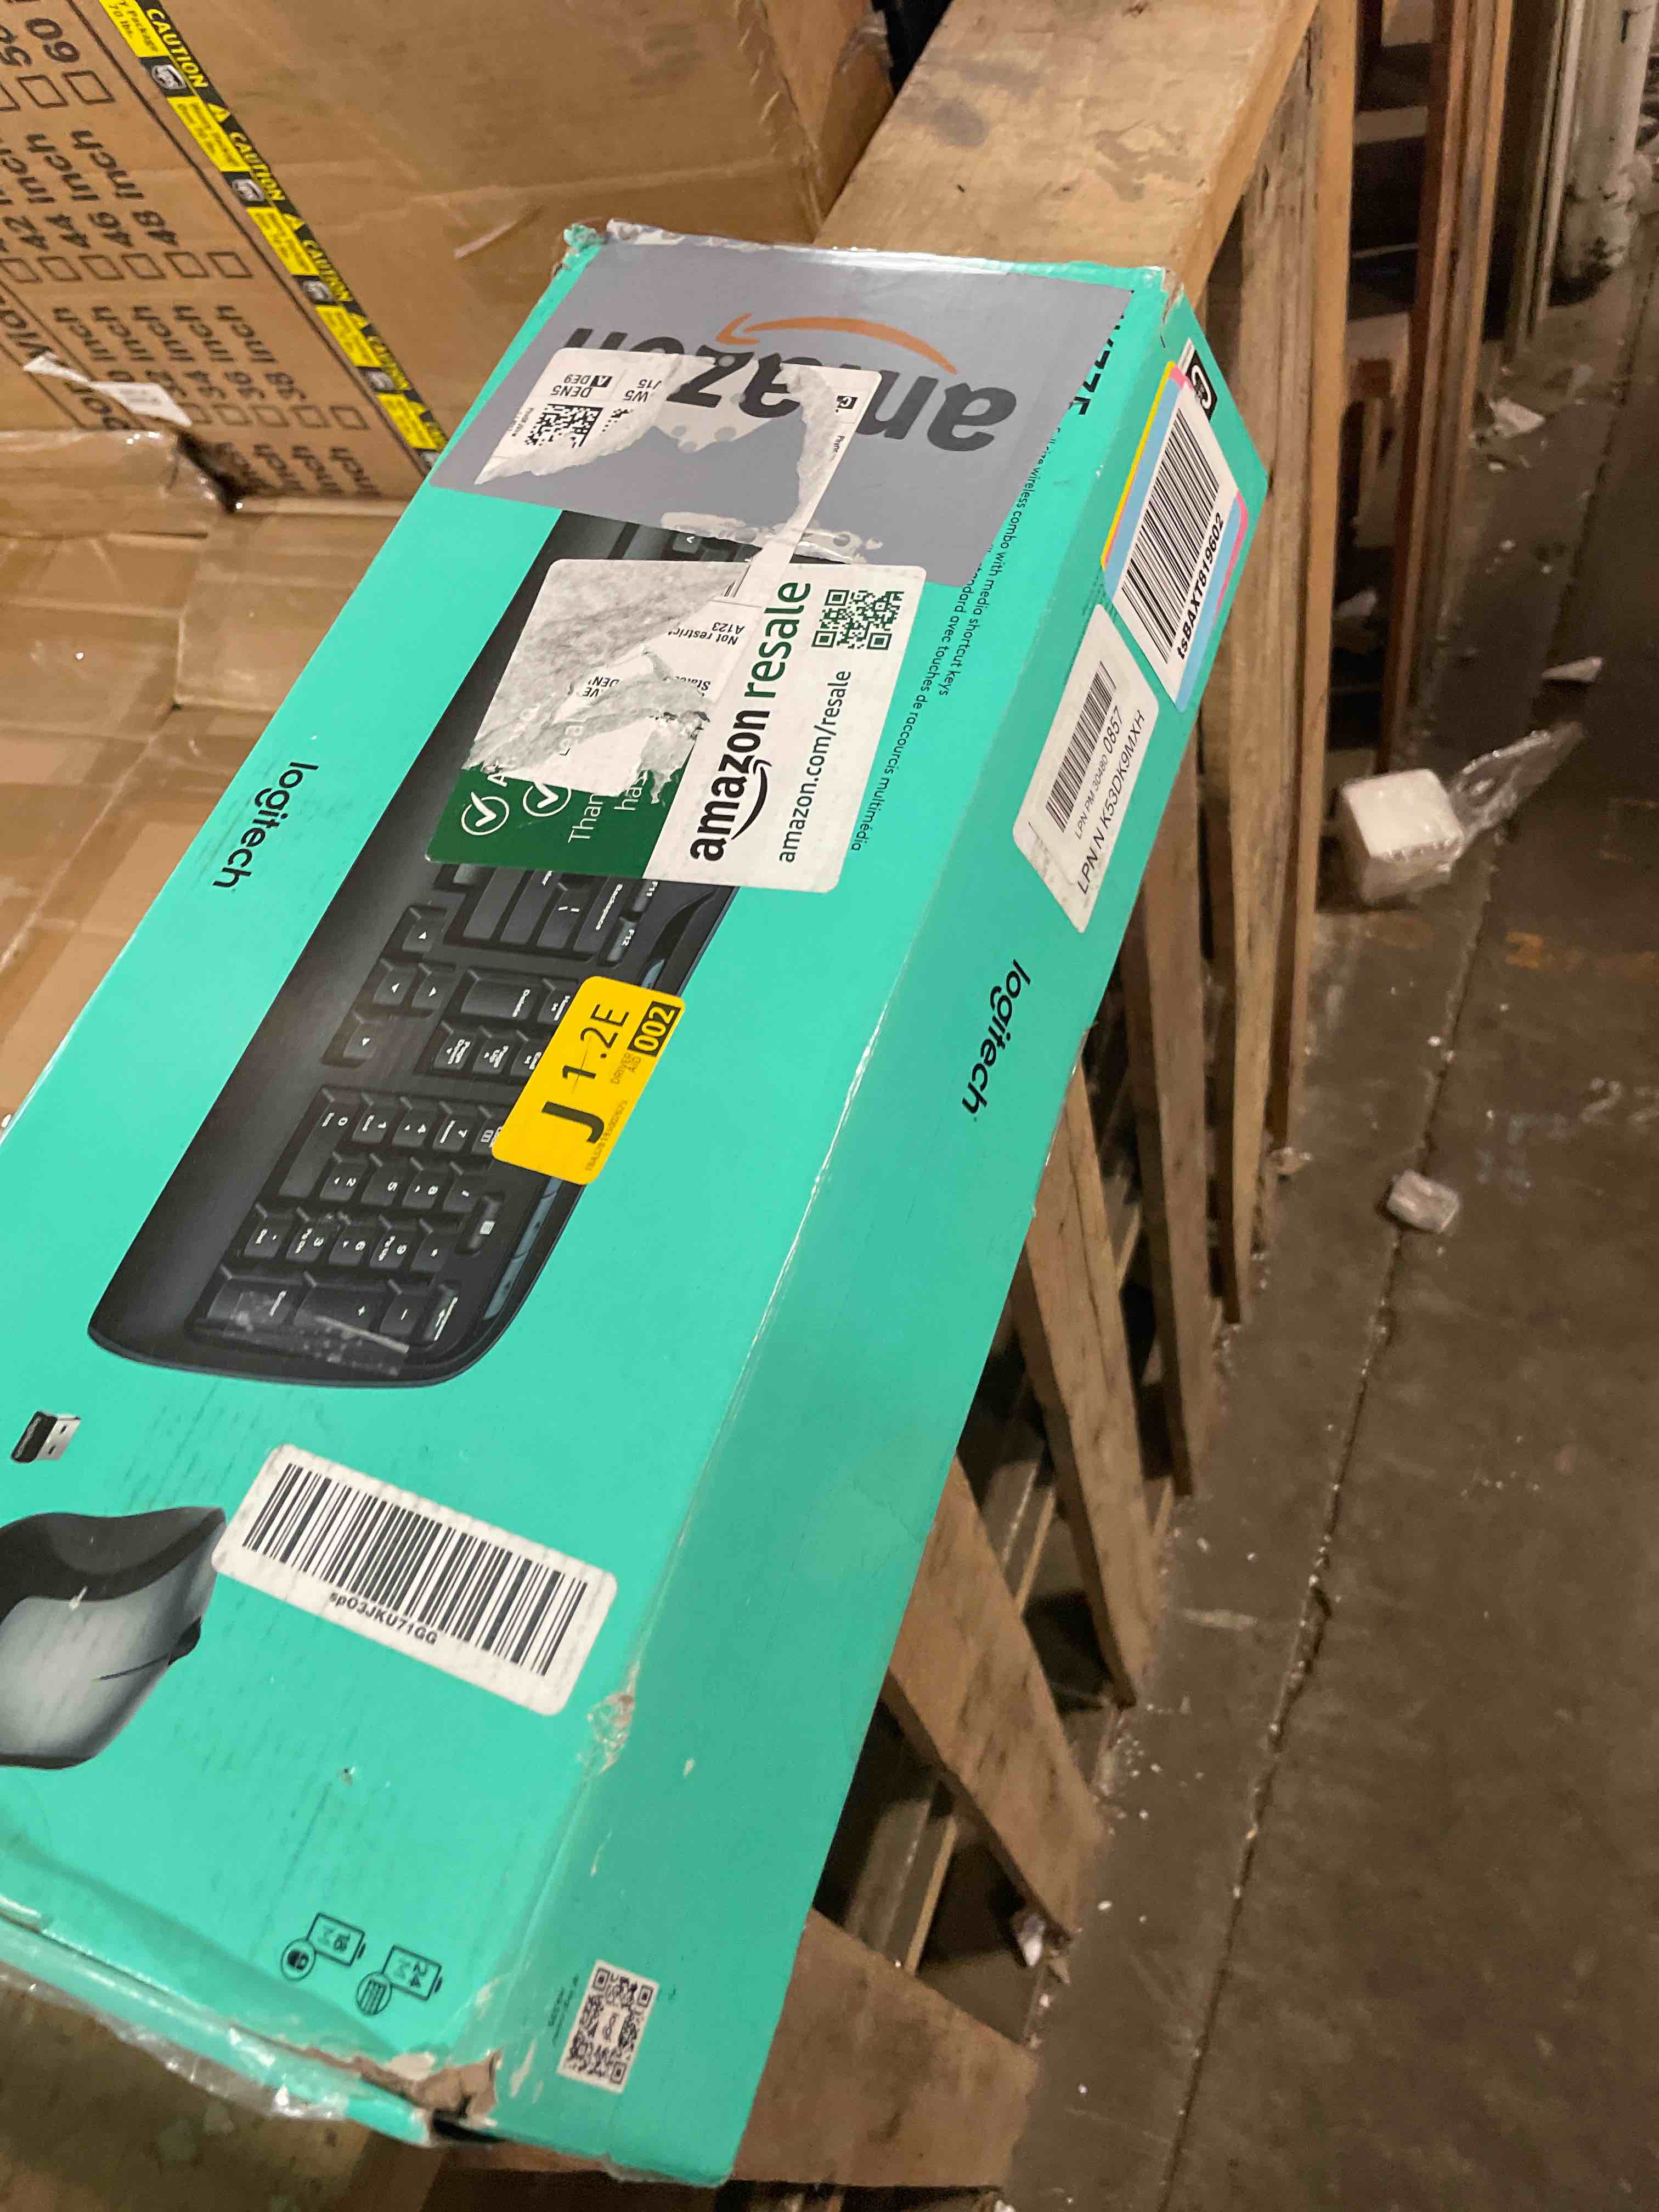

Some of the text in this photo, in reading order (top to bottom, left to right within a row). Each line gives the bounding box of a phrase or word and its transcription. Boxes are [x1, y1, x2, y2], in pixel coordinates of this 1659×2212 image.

[25, 17, 80, 63] 60
[146, 8, 209, 88] CAUTION
[230, 132, 285, 201] CAUTION
[2, 216, 49, 250] 42
[44, 213, 91, 249] 44
[87, 212, 134, 247] 46
[131, 210, 179, 247] 48
[551, 385, 593, 398] DEN5
[938, 467, 1041, 696] wireless combo with media shortcut keys
[1176, 511, 1224, 661] tsBAXT819602
[712, 622, 746, 634] A123
[715, 634, 739, 645] Not
[941, 616, 960, 642] avec
[921, 646, 949, 692] touches
[690, 579, 811, 862] amazon resale
[913, 694, 928, 709] de
[884, 712, 918, 774] raccourcis
[779, 669, 853, 865] amazon.com/resale
[1075, 811, 1089, 840] LPN
[1105, 705, 1123, 754] 0857
[212, 761, 319, 888] logitech
[851, 777, 890, 851] multimédia
[1076, 847, 1098, 895] LPN
[1091, 825, 1105, 849] N
[622, 929, 635, 947] F12
[633, 1006, 675, 1053] 002
[961, 958, 1031, 1114] logitech
[610, 1052, 634, 1085] DRIVER
[541, 1101, 605, 1144] J
